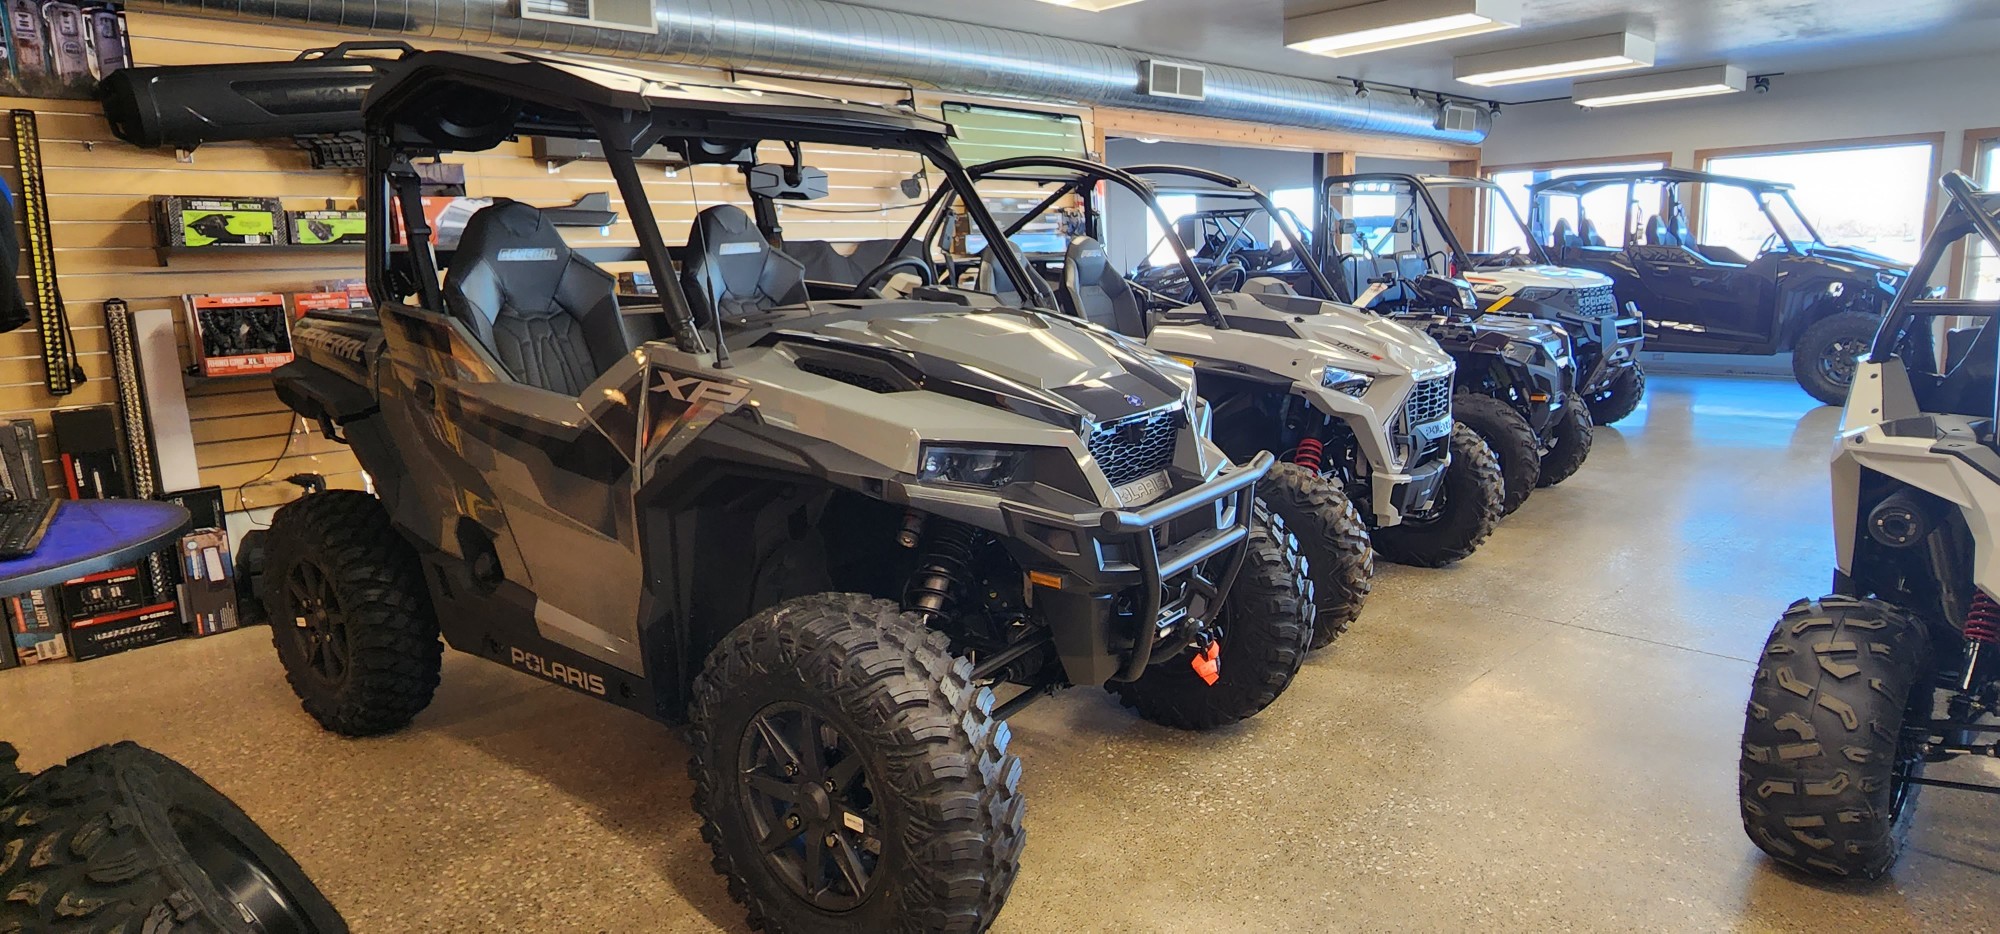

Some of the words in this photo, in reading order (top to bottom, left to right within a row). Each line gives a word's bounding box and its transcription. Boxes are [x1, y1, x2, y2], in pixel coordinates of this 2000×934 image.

[295, 327, 366, 362] GENERAL
[649, 370, 753, 404] XP
[1118, 472, 1168, 504] OLARIS
[34, 606, 50, 628] LIGHT
[511, 646, 606, 695] POLARIS
